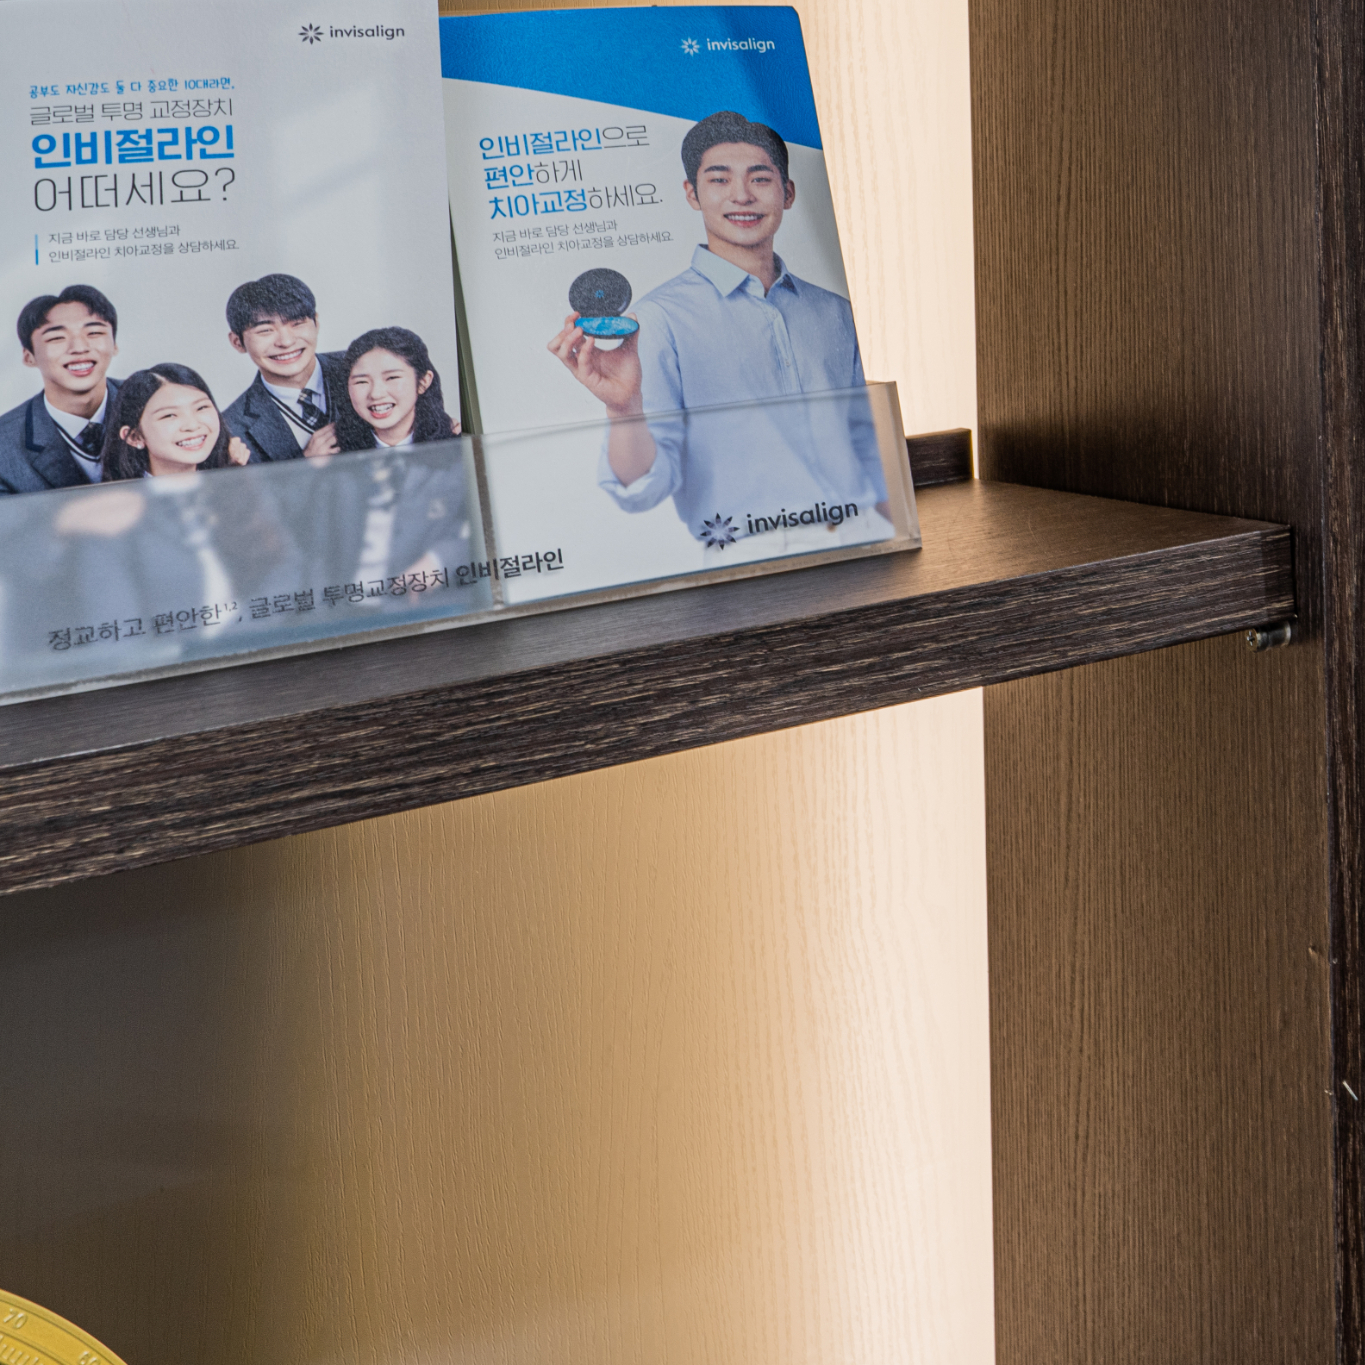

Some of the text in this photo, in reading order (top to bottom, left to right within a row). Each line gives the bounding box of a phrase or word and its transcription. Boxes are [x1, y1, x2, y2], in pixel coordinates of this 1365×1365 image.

[329, 24, 405, 41] invisalign
[706, 37, 776, 54] invisalign
[29, 85, 60, 99] 공부도
[66, 82, 110, 96] 자신감도
[114, 80, 125, 94] 둘
[130, 82, 142, 92] 다
[147, 78, 179, 93] 중요한
[30, 98, 233, 126] 글로벌 투명 교정장치
[32, 125, 236, 169] 인비절라인
[480, 125, 650, 160] 인비절라인으로
[484, 159, 584, 190] 편안하게
[34, 167, 236, 212] 어떠세요?
[488, 183, 664, 220] 치아교정하세요.
[48, 224, 181, 244] 지금 바로 담당 선생님과
[492, 220, 618, 244] 지금 바로 담당 선생님과
[48, 246, 111, 263] 인비절라인
[114, 242, 175, 258] 치아교정을
[494, 242, 555, 260] 인비절라인
[558, 235, 614, 252] 치아교정을
[747, 500, 859, 534] invisalign
[49, 618, 146, 652] 정교하고
[248, 587, 316, 618] 글로벌
[322, 566, 452, 607] 투명교정장치
[456, 548, 564, 585] 인비절라인
